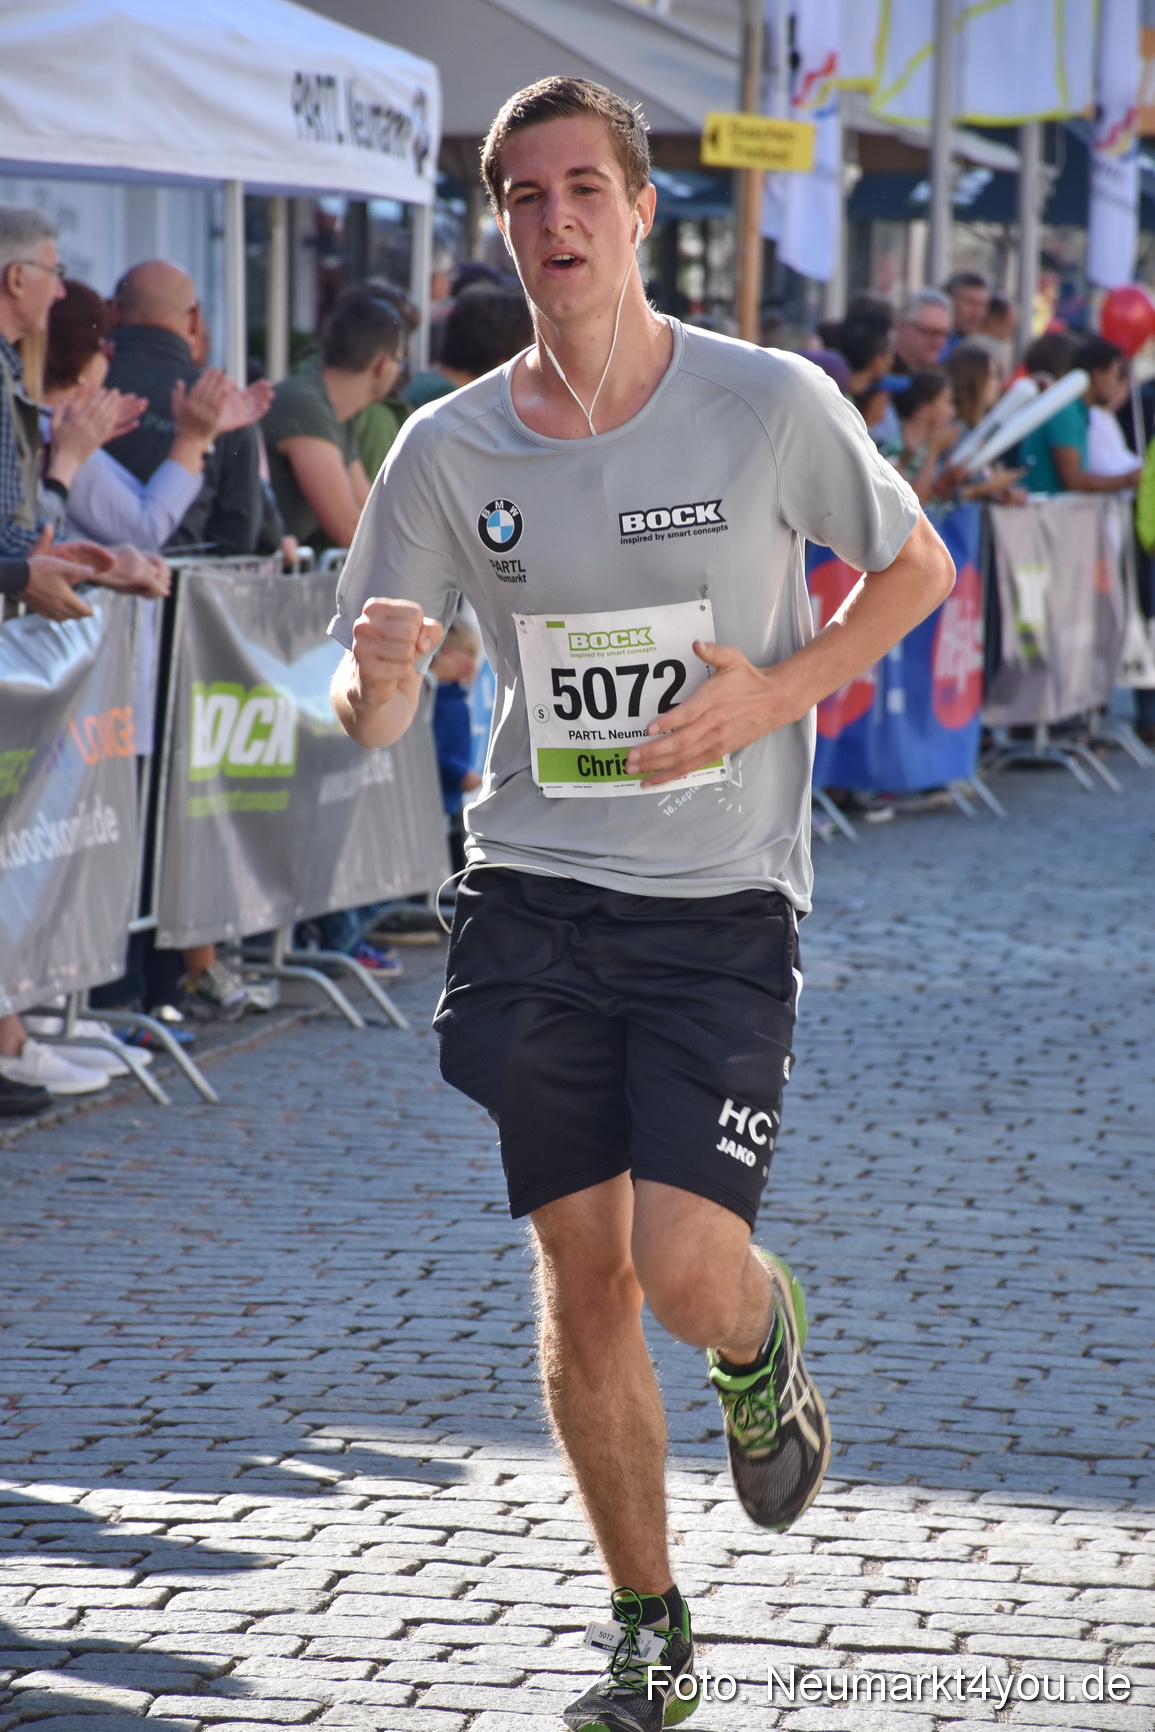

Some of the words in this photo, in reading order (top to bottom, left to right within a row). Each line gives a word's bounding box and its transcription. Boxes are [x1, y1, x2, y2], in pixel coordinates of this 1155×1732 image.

[481, 500, 520, 520] BMW
[619, 499, 727, 537] BOCK
[620, 533, 653, 545] inspired
[655, 532, 665, 542] by
[667, 529, 692, 539] smart
[693, 524, 729, 536] concepts
[489, 559, 527, 574] PARTL
[568, 626, 656, 652] BOCK
[570, 650, 596, 660] inspired
[597, 650, 605, 658] by
[606, 649, 626, 657] smart
[627, 645, 658, 655] concepts
[551, 659, 687, 721] 5072
[568, 729, 606, 741] PARTL
[608, 727, 654, 741] Neuma
[577, 753, 630, 777] Chris
[663, 804, 678, 817] 16.
[675, 784, 704, 807] Septe
[716, 1136, 757, 1168] JAKO
[598, 1631, 615, 1642] 5072
